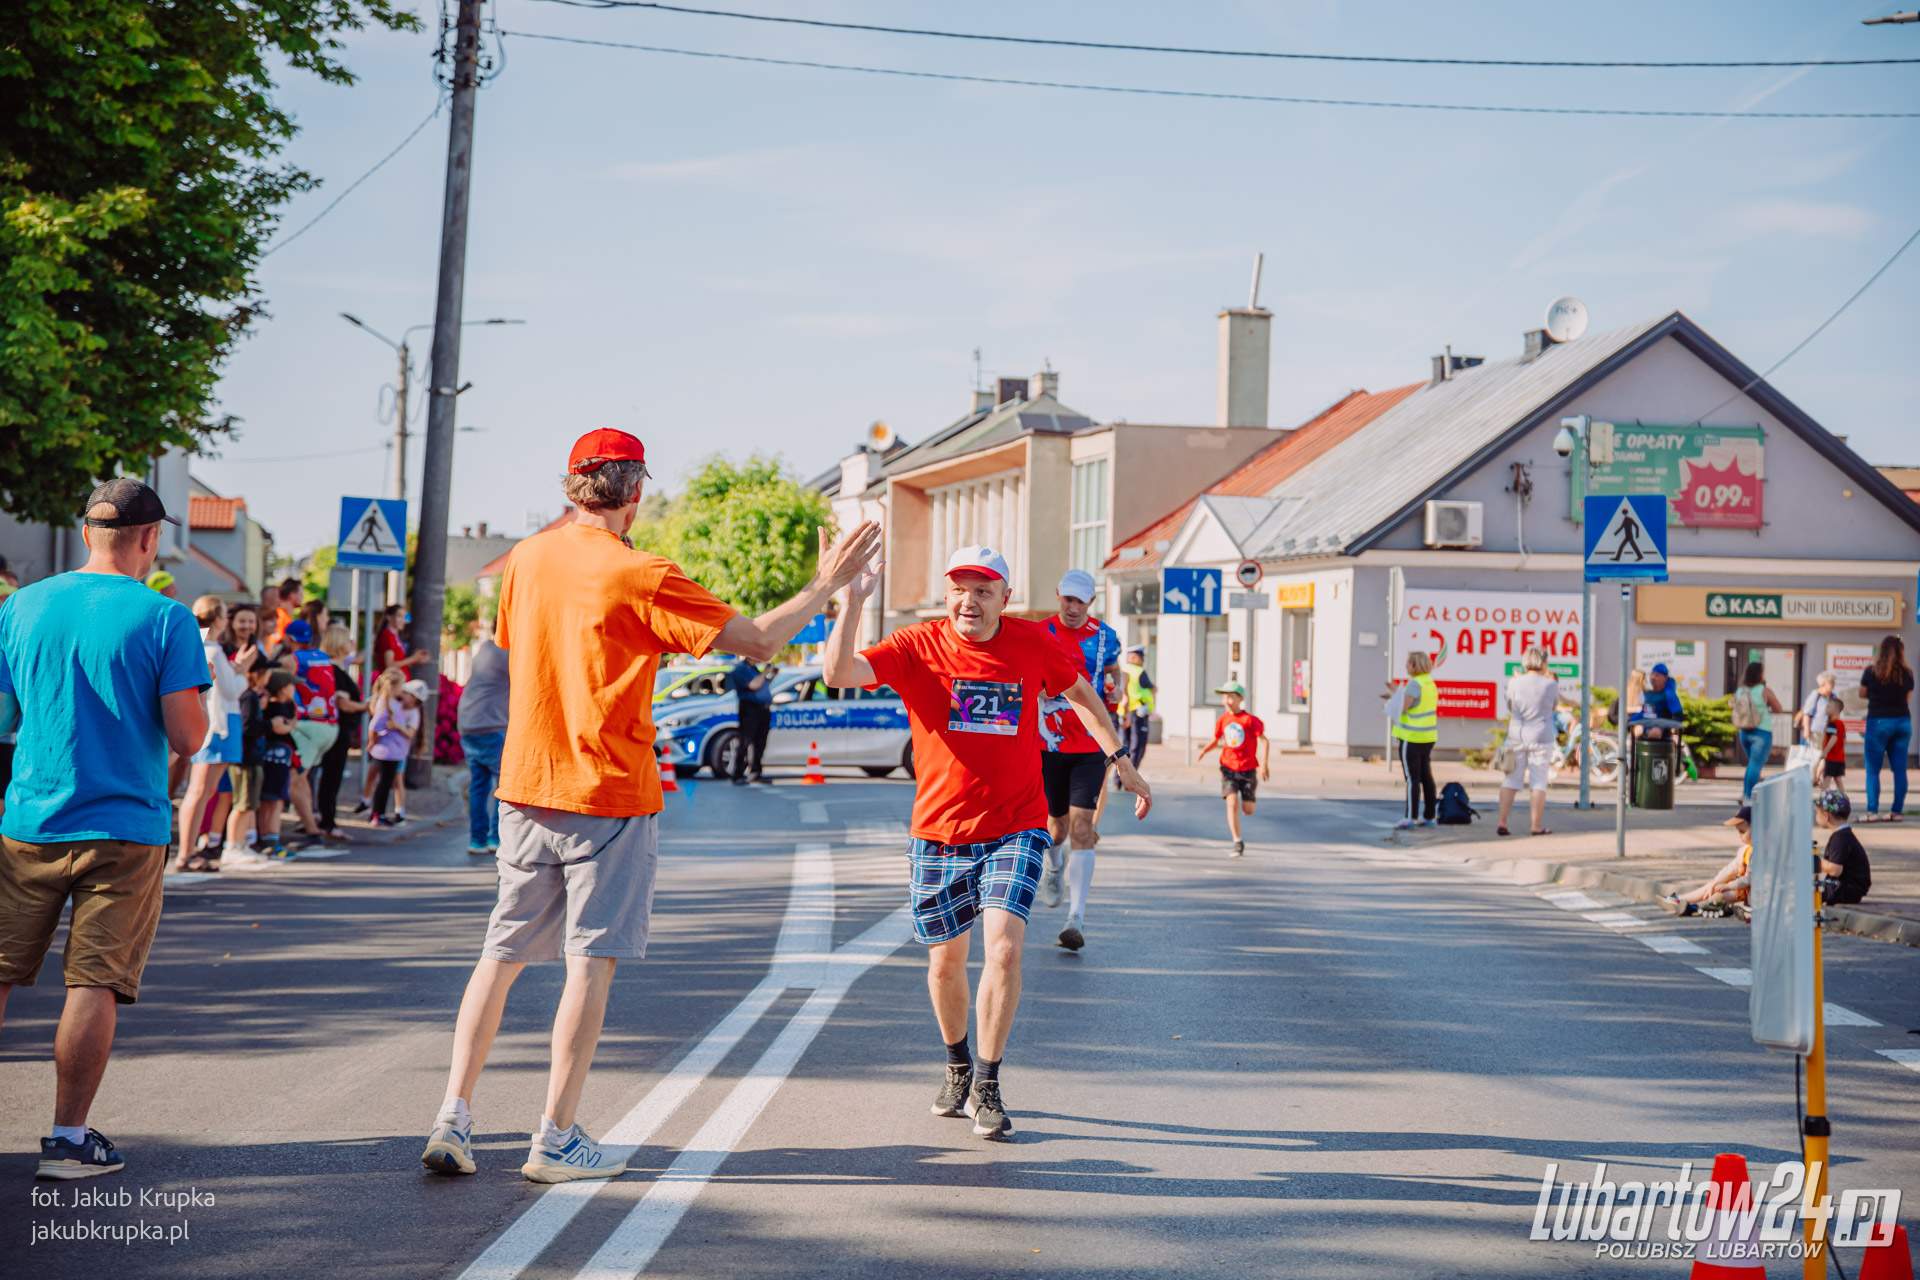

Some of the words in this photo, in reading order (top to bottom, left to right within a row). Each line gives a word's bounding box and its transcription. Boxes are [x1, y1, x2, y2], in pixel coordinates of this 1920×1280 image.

[1626, 434, 1686, 449] OPŁATY
[1408, 605, 1580, 625] CAŁODOBOWA
[1729, 598, 1778, 614] KASA
[1786, 599, 1816, 614] UNII
[1821, 600, 1890, 616] LUBELSKIEJ
[1456, 629, 1579, 656] APTEKA
[972, 694, 1001, 716] 21
[776, 713, 827, 726] POLICJA
